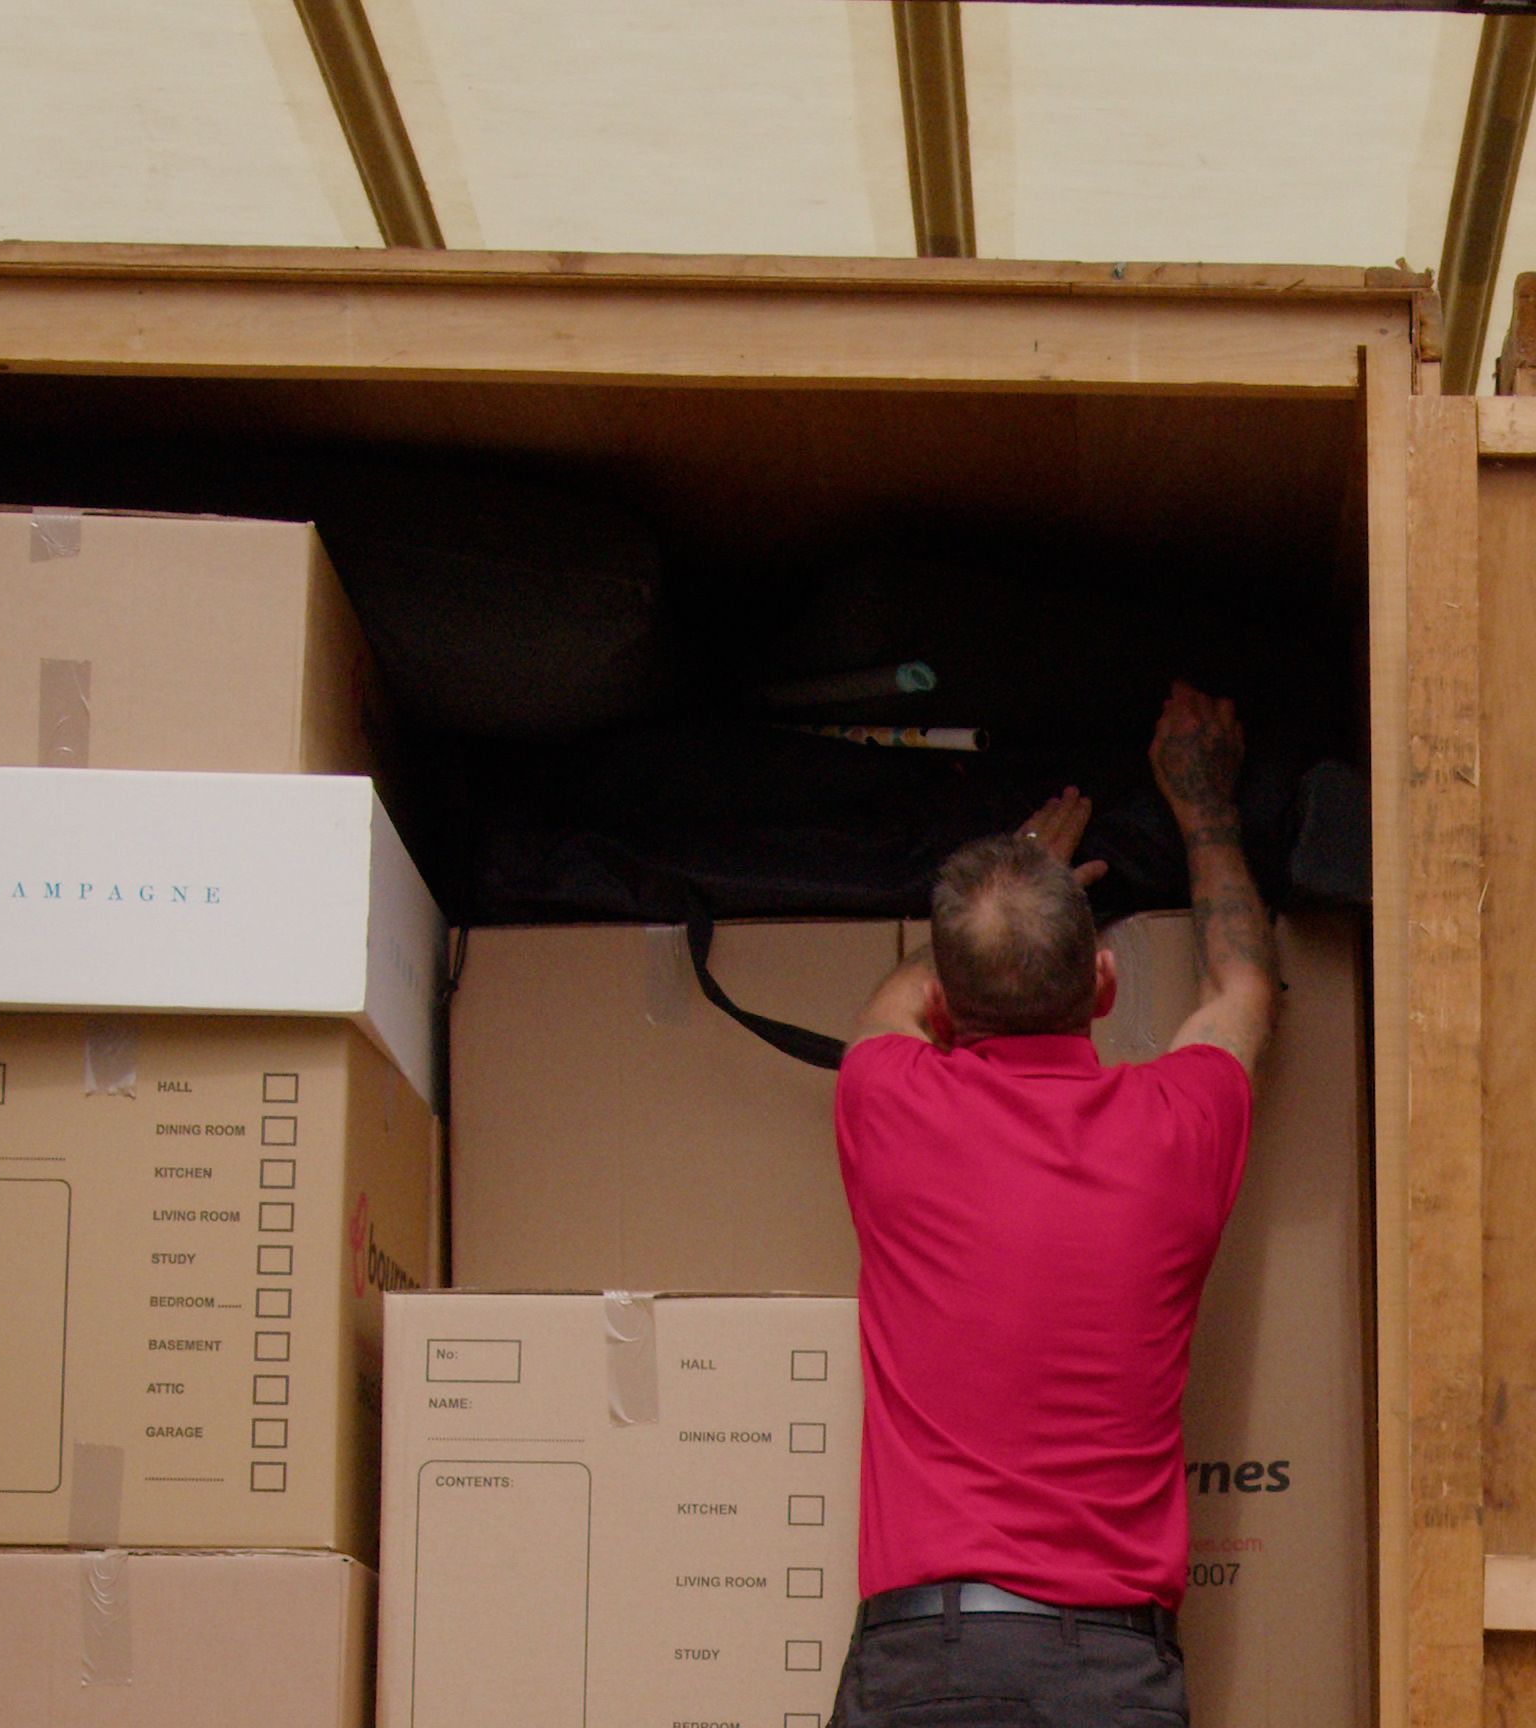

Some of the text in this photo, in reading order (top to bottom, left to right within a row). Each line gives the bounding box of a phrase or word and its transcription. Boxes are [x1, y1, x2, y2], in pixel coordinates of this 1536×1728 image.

[157, 1081, 192, 1093] HALL
[155, 1124, 246, 1137] DINING ROOM
[154, 1167, 212, 1179] KITCHEN
[152, 1210, 240, 1223] LIVING ROOM
[151, 1253, 196, 1265] STUDY
[149, 1296, 215, 1308] BEDROOM
[148, 1339, 221, 1352] BASEMENT
[436, 1348, 458, 1360] No:
[680, 1359, 717, 1371] HALL
[146, 1382, 185, 1395] ATTIC
[428, 1398, 473, 1410] NAME:
[145, 1426, 203, 1439] GARAGE
[679, 1431, 772, 1443] DINING ROOM
[435, 1476, 514, 1488] CONTENTS:
[677, 1503, 738, 1516] KITCHEN
[675, 1576, 767, 1588] LIVING ROOM
[674, 1649, 720, 1661] STUDY
